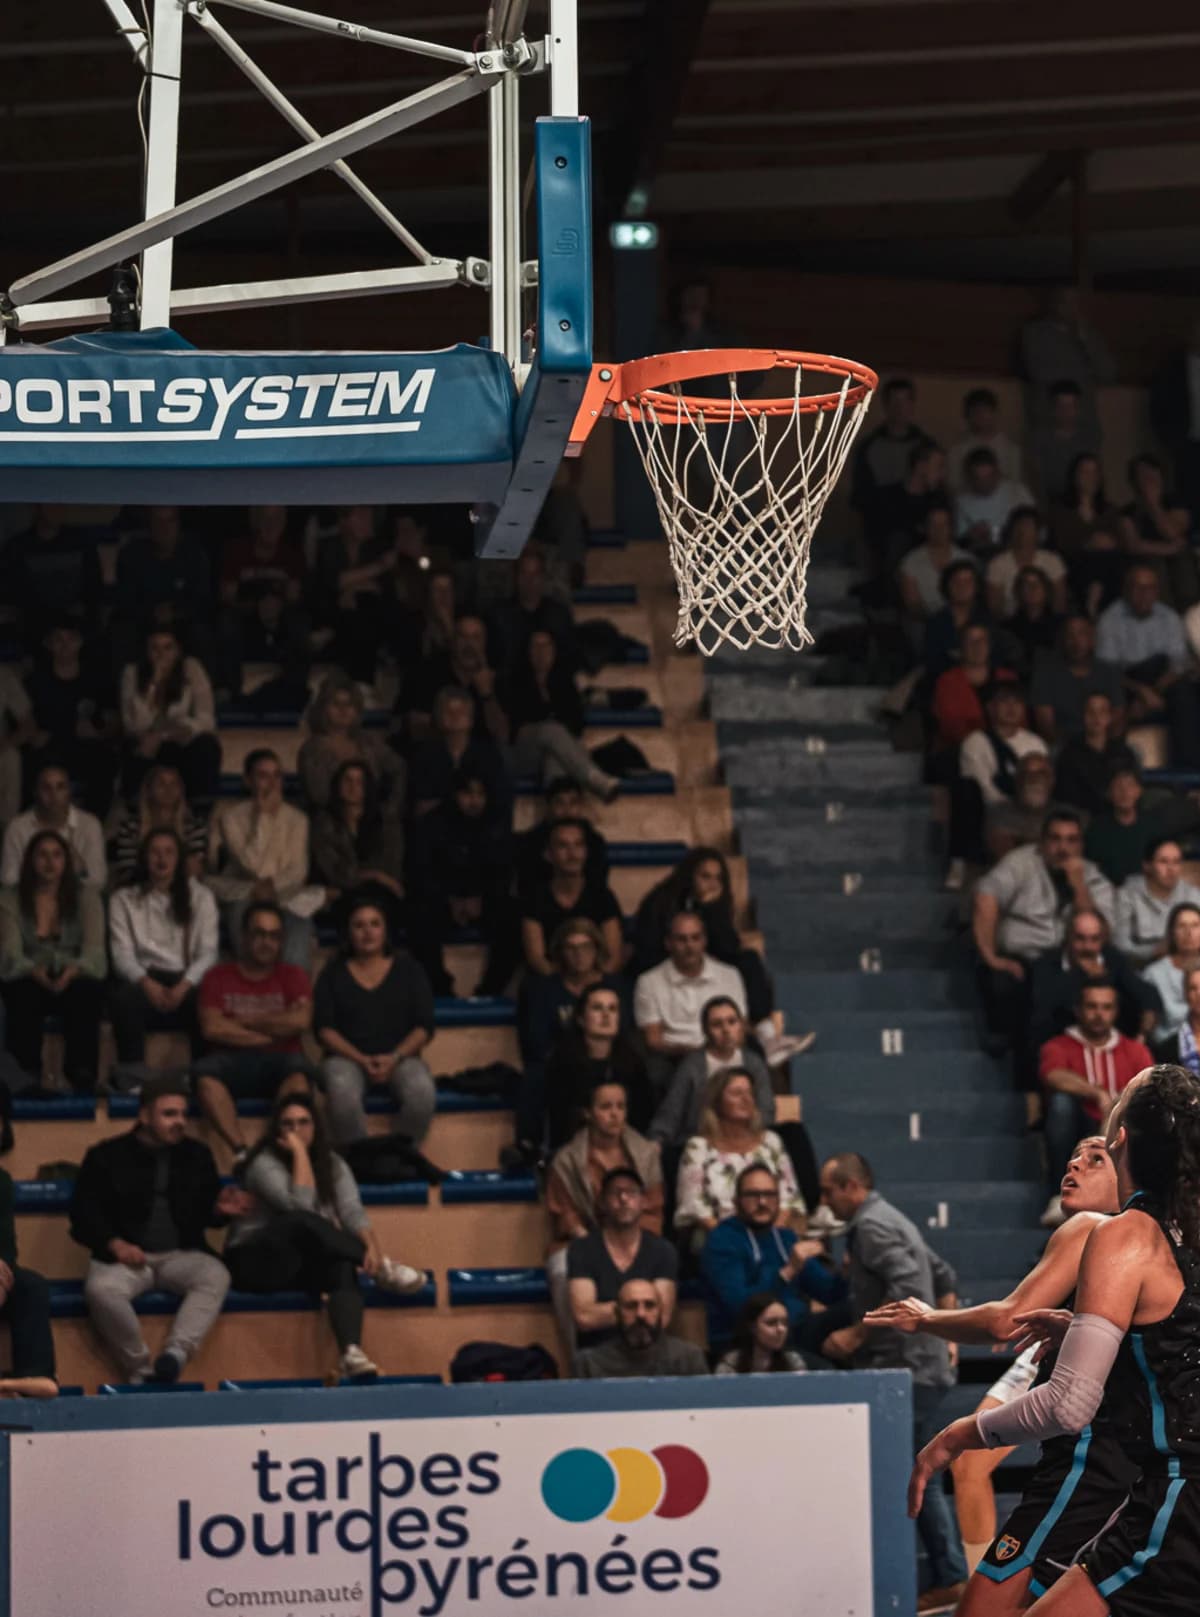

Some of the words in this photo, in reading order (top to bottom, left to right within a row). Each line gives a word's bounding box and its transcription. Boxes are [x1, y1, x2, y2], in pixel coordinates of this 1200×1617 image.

[252, 1432, 501, 1504] tarbes
[179, 1499, 470, 1561] lourdes
[205, 1581, 364, 1608] Communauté
[370, 1533, 721, 1617] pyrénées
